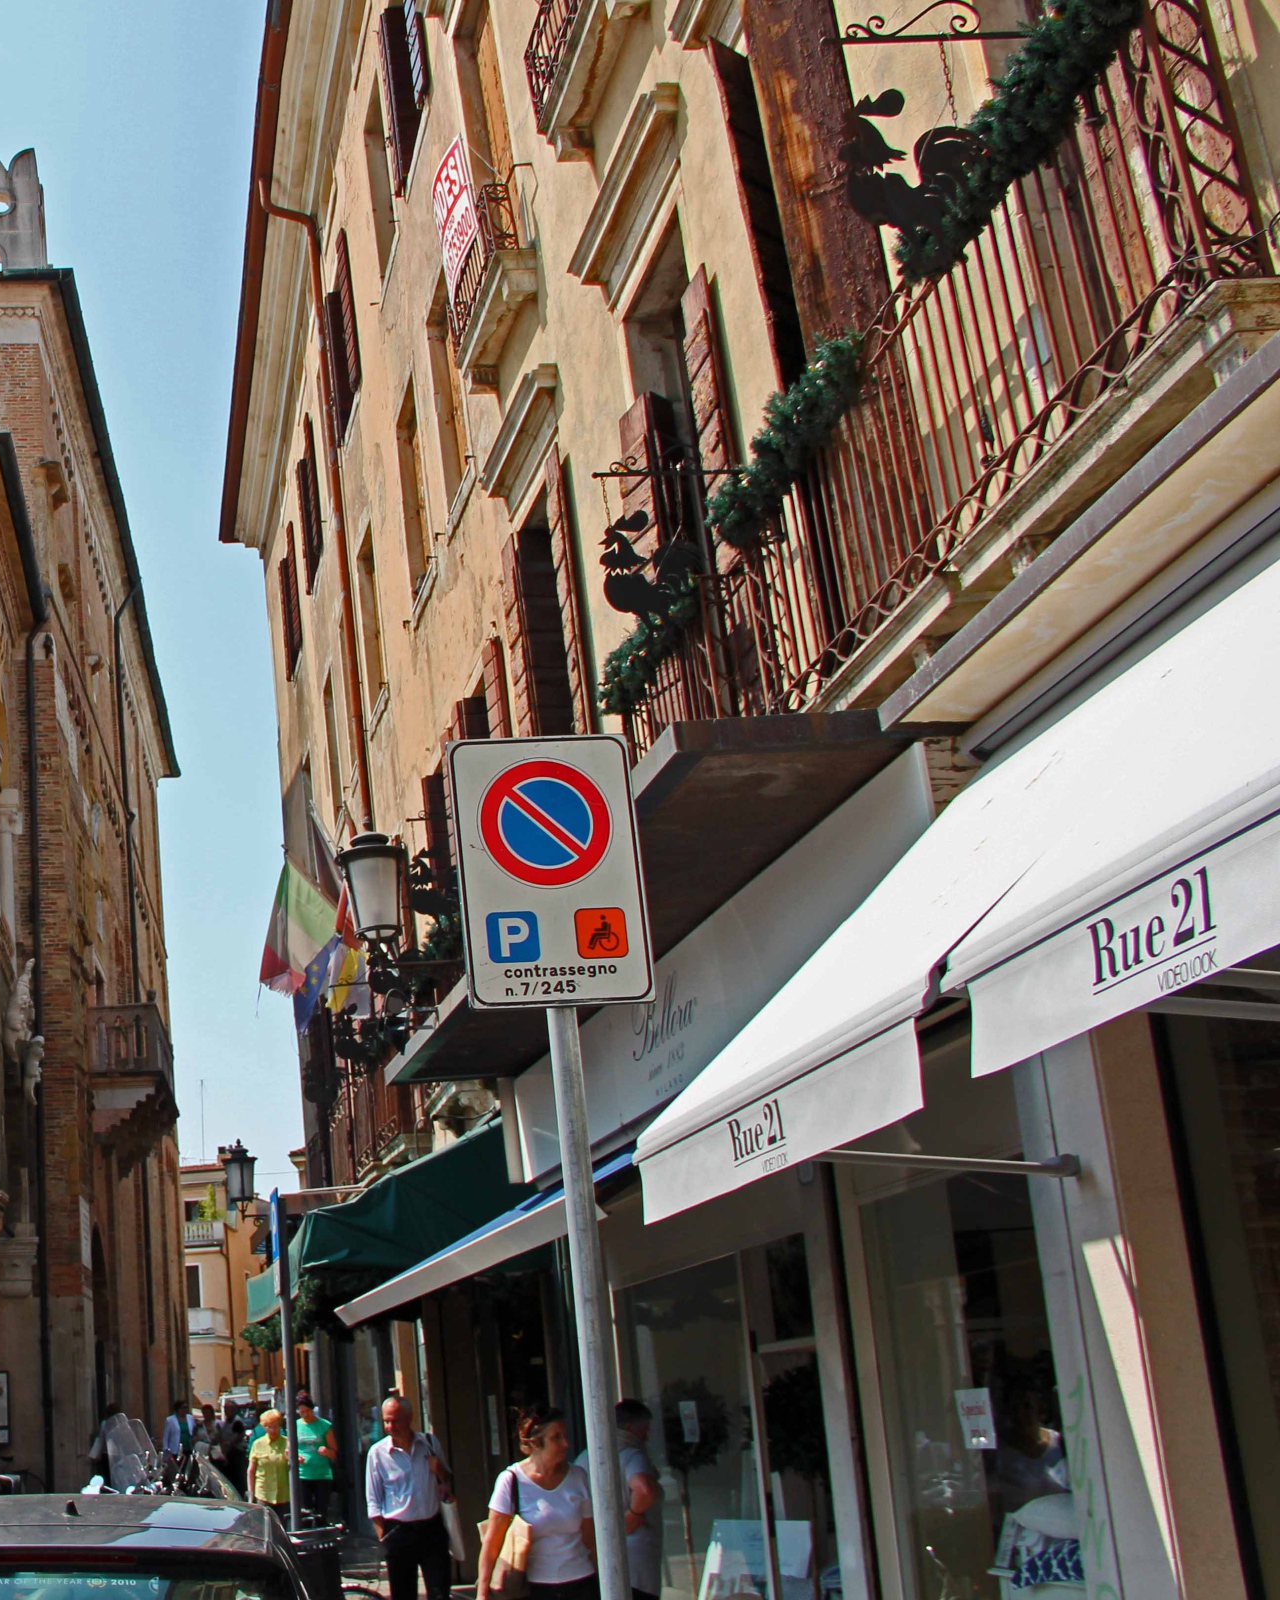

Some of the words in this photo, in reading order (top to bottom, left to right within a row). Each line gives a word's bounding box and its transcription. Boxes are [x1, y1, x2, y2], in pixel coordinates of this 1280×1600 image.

[498, 917, 530, 958] P
[1086, 915, 1165, 986] Rue
[1171, 866, 1218, 947] 21
[504, 964, 617, 979] contrassegno
[631, 970, 694, 1062] Bellora
[727, 1118, 764, 1162] Rue
[763, 1098, 786, 1145] 21
